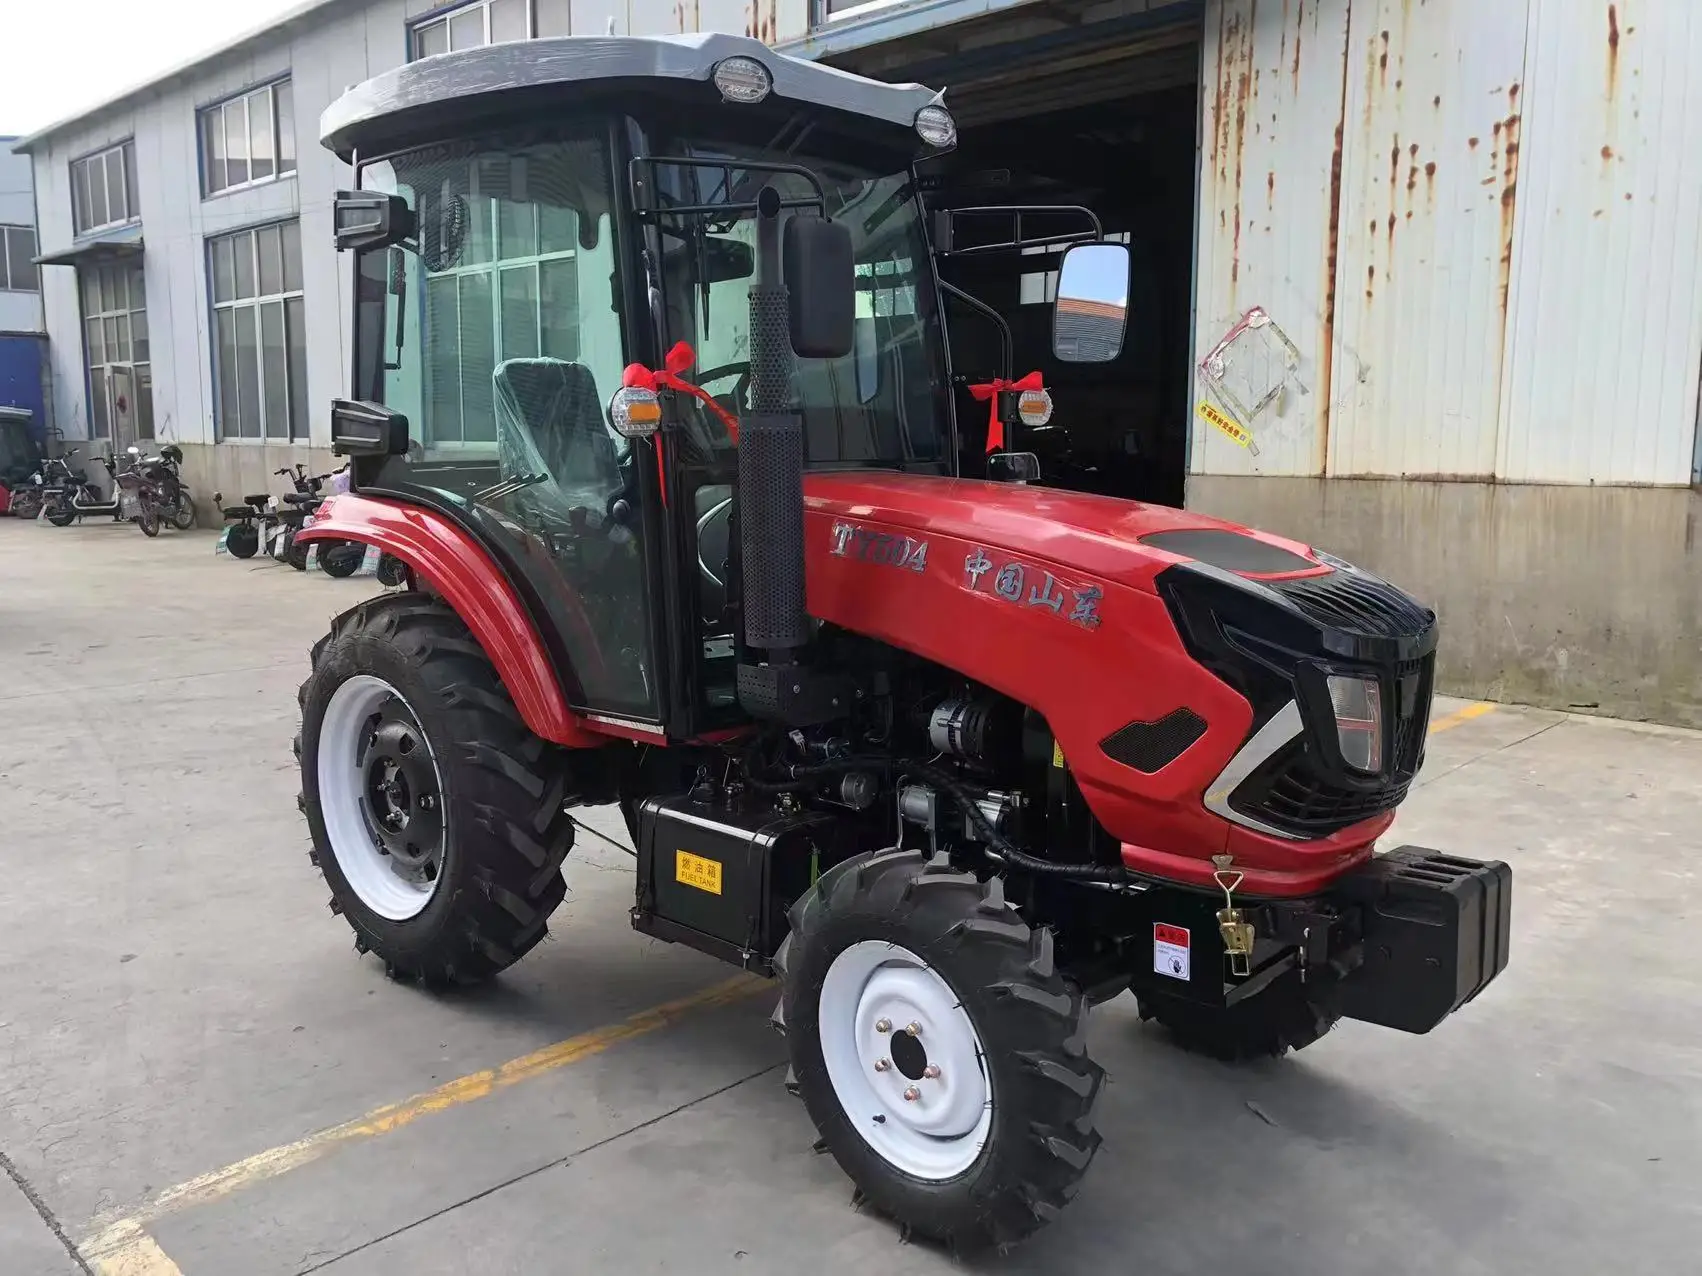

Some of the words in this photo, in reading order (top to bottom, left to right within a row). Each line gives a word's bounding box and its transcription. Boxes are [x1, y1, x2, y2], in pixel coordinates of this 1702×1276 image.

[965, 547, 1103, 627] 中国山东
[681, 857, 716, 878] 燃油箱
[681, 871, 698, 882] FUEL
[699, 877, 716, 888] TANK
